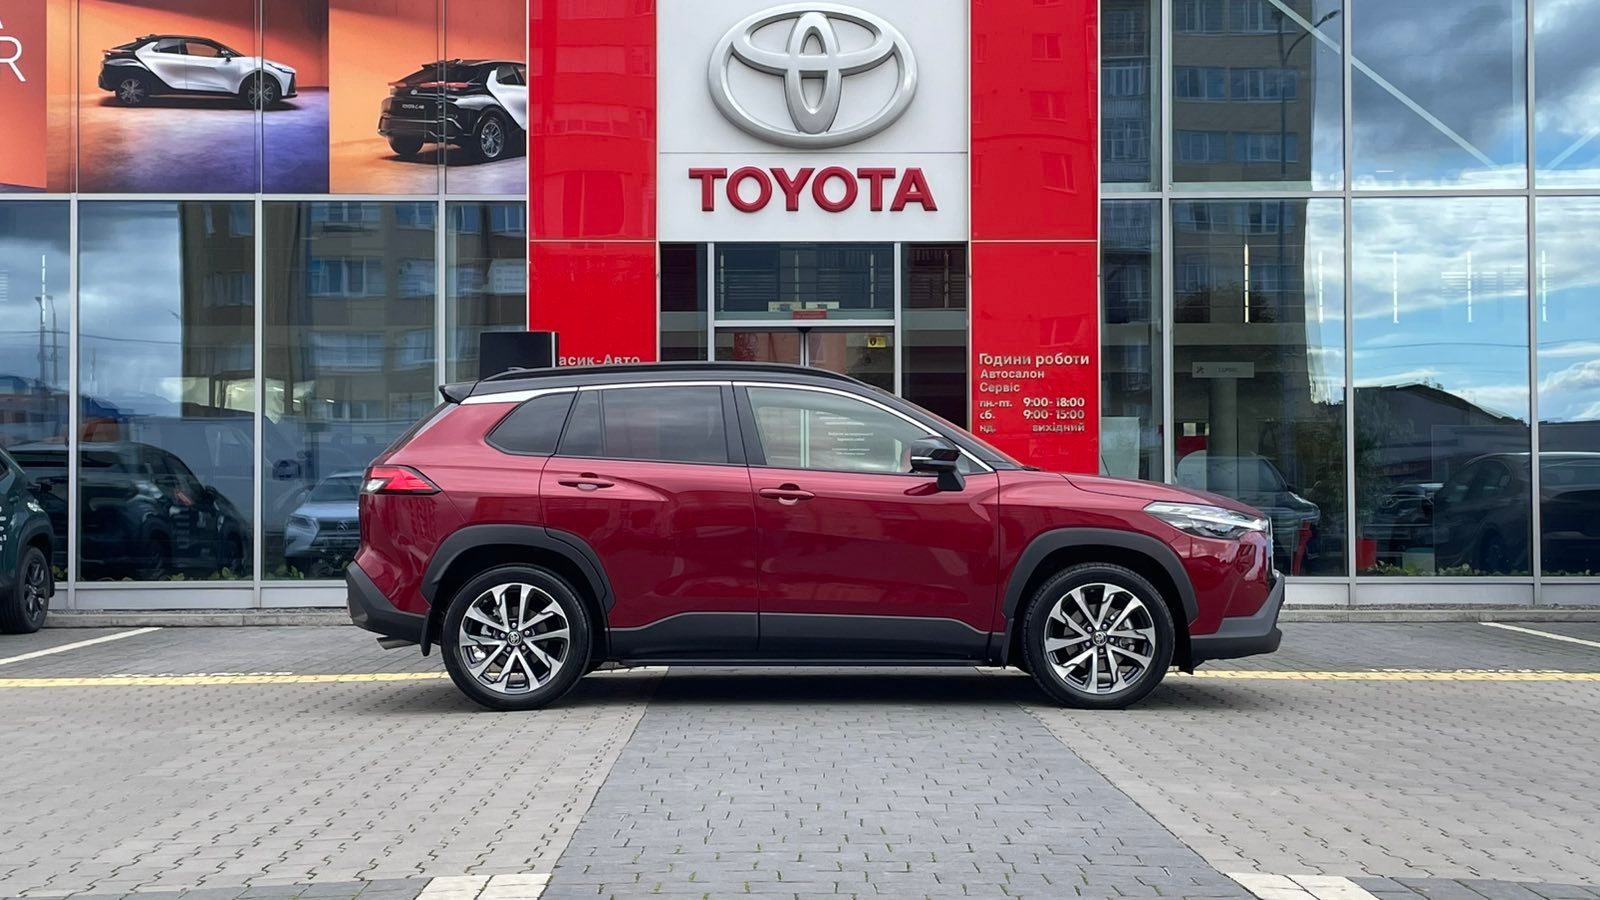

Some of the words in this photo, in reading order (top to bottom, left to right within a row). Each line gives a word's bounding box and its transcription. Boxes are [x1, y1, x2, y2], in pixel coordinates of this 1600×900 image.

[688, 166, 937, 213] TOYOTA
[978, 352, 1032, 367] Години
[1035, 352, 1090, 368] роботи
[980, 368, 1045, 379] Автосалон
[979, 381, 1021, 395] Сервіс
[979, 409, 996, 420] сб.
[1032, 422, 1085, 433] вихідний
